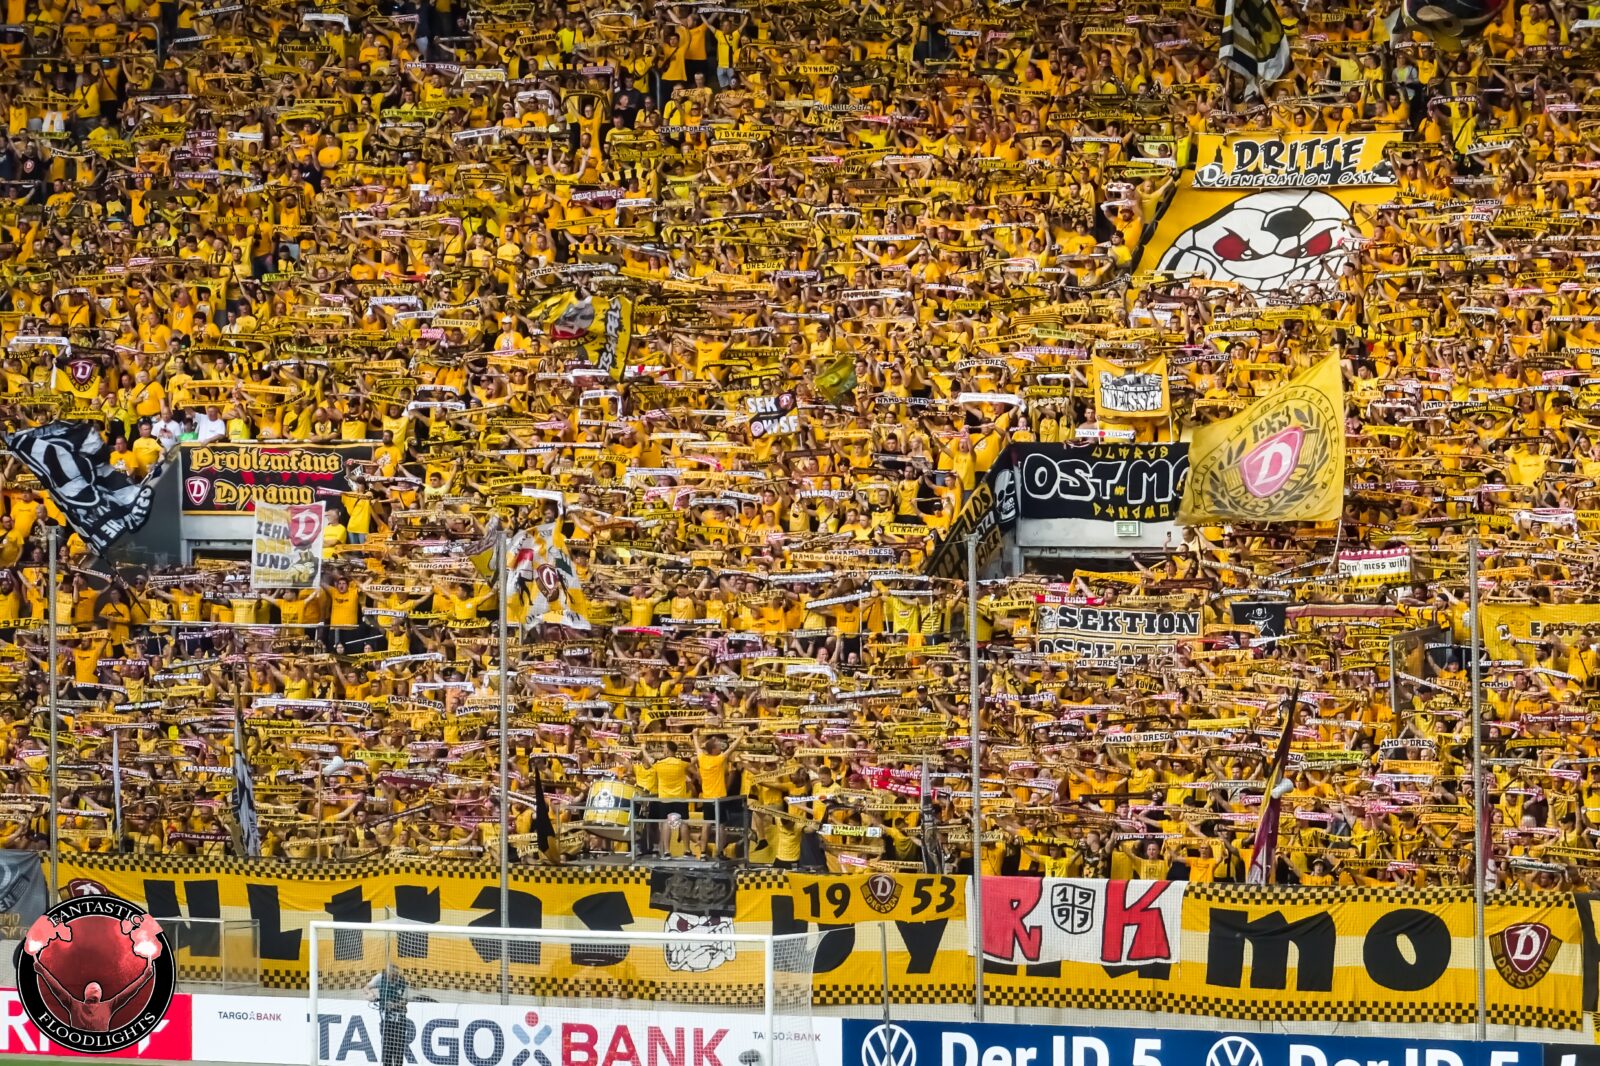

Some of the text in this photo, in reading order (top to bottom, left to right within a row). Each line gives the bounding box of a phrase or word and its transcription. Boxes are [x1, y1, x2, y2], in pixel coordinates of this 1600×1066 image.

[802, 65, 836, 74] DYNAMO
[724, 131, 761, 140] DYNAMO
[1234, 136, 1364, 173] DRITTE
[1218, 172, 1332, 190] GENERATION
[1337, 171, 1374, 186] OST
[746, 397, 778, 416] SEK
[763, 416, 799, 435] WSF
[1253, 405, 1292, 444] 1953
[191, 447, 341, 477] Problemfans
[1023, 454, 1126, 502] OST
[212, 482, 316, 514] Dynamo
[889, 526, 924, 536] DYNAMO
[256, 554, 290, 570] UND
[1363, 560, 1387, 571] mess
[1388, 557, 1408, 569] with
[1058, 606, 1200, 637] SEKTION
[457, 706, 480, 715] NAMO
[1105, 734, 1132, 743] NAMO
[1380, 739, 1400, 749] AMO
[802, 878, 956, 919] 19 53
[866, 893, 899, 914] DRESDEN
[1494, 955, 1551, 988] DRESDEN
[218, 1011, 282, 1022] TARGO BANK
[307, 1013, 729, 1066] TARGO BANK
[753, 1031, 786, 1042] TAGO
[941, 1031, 1037, 1066] Der
